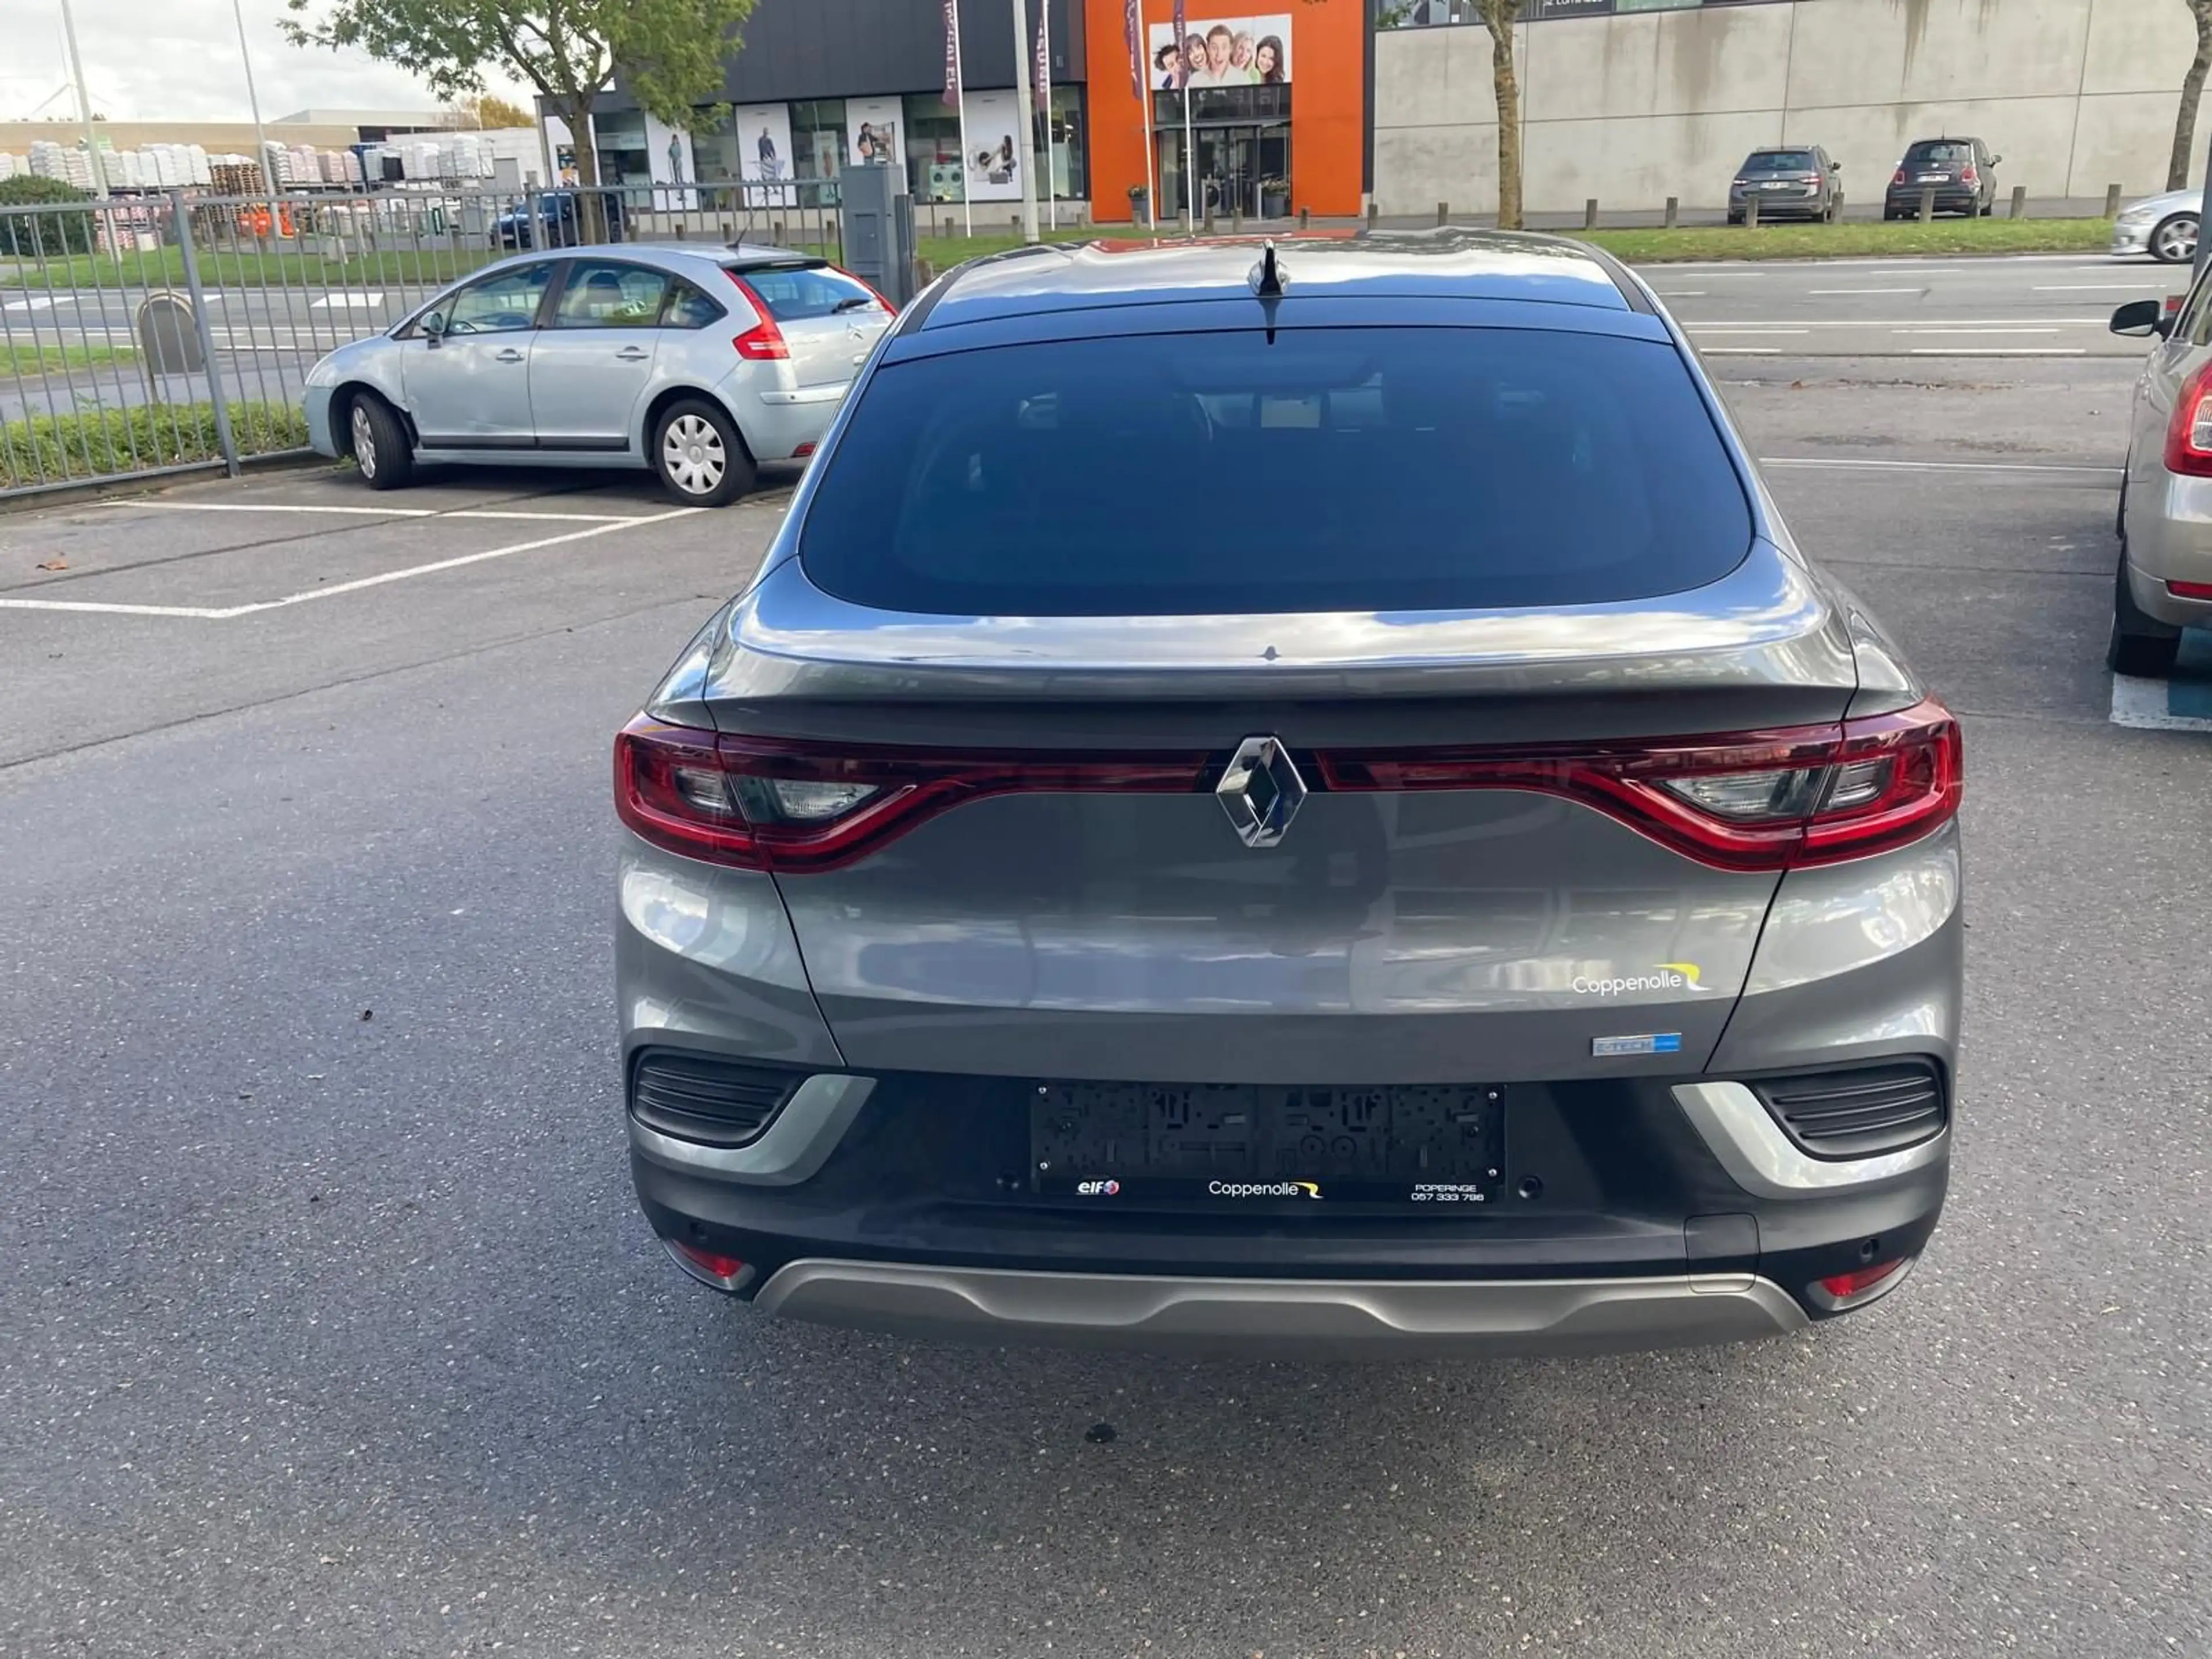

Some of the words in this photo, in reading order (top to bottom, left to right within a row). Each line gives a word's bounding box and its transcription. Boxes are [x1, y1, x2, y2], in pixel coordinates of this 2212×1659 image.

[1572, 970, 1682, 996] Coppenolle
[1078, 1181, 1104, 1193] elf
[1209, 1181, 1299, 1198] Coppenolle
